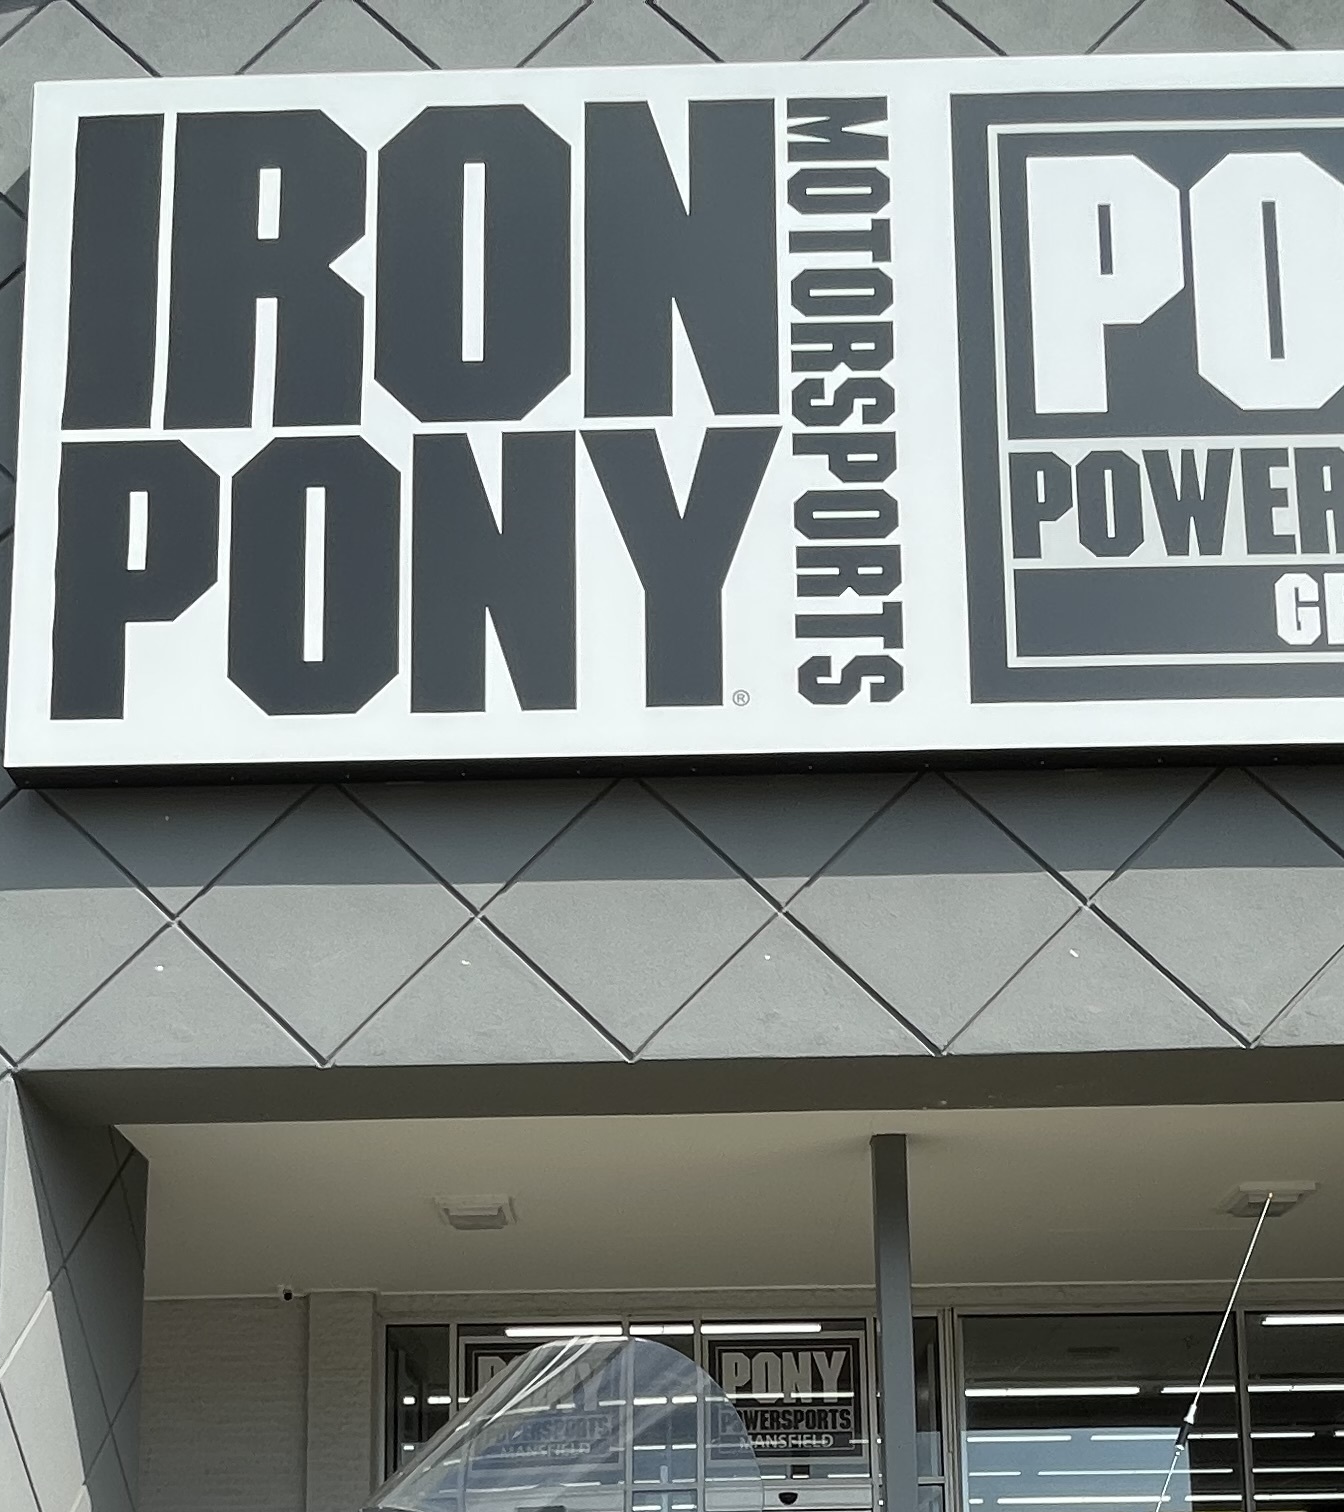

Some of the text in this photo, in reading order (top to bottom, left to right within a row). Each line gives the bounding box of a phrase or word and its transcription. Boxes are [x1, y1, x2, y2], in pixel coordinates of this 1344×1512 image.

[61, 98, 781, 430] IRON
[786, 96, 904, 706] MOTORSPORTS
[50, 426, 782, 721] PONY
[720, 1408, 852, 1434] POWERSPORTS
[722, 1351, 847, 1404] PONY
[740, 1434, 834, 1449] MANSFIELD
